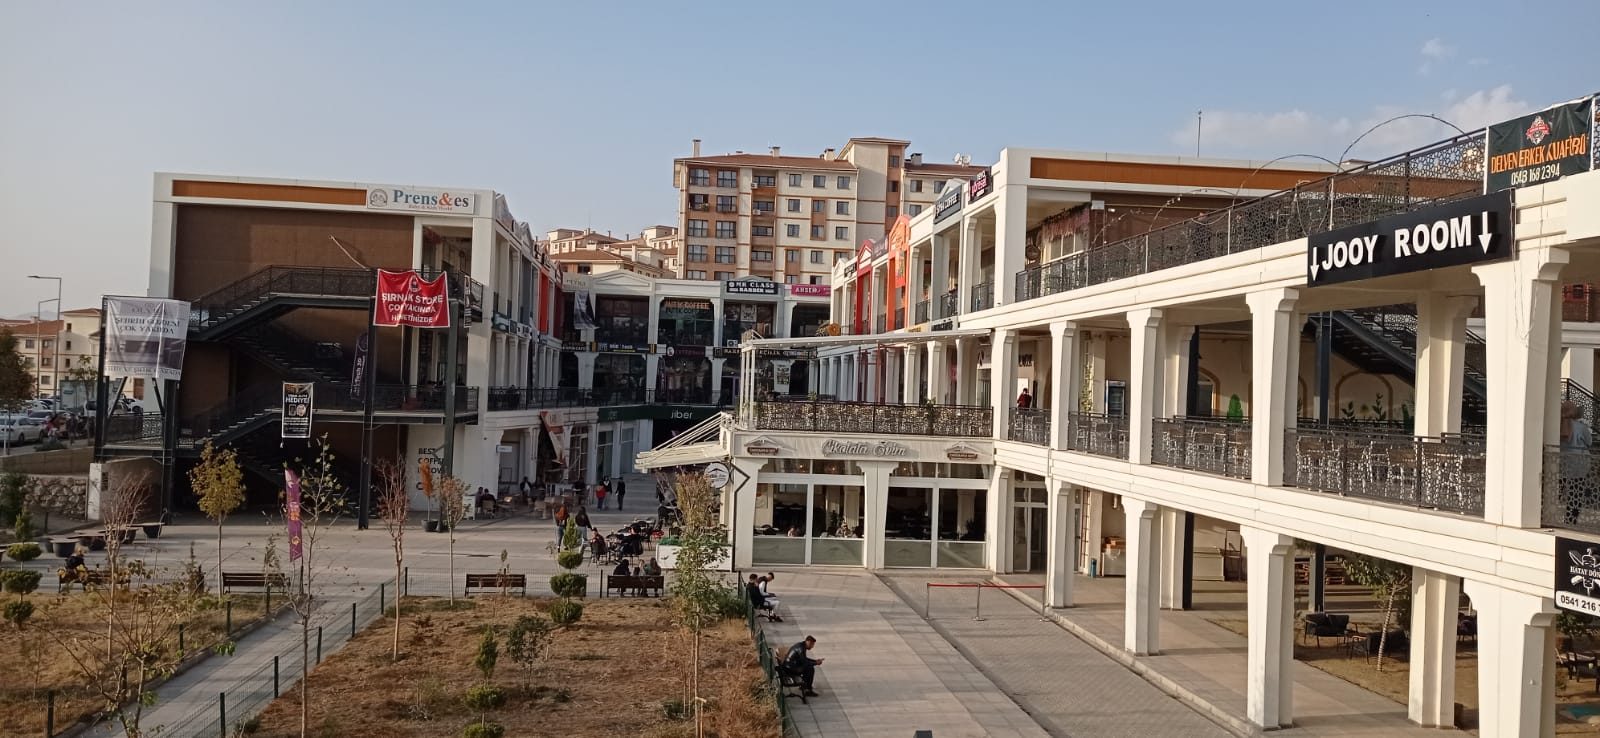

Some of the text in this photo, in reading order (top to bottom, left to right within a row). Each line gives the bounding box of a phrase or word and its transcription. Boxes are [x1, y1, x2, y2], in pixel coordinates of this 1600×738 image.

[1491, 151, 1520, 174] DELVEN
[1519, 145, 1545, 168] ERKEK
[1529, 167, 1541, 182] 168
[1541, 162, 1561, 179] 2394
[392, 189, 469, 208] Prens&es
[1322, 215, 1472, 271] JOOY ROOM
[388, 304, 404, 313] ÇO
[415, 294, 444, 305] STORE
[1570, 566, 1588, 576] HATAY
[1560, 594, 1579, 607] 0541
[1582, 600, 1596, 611] 216
